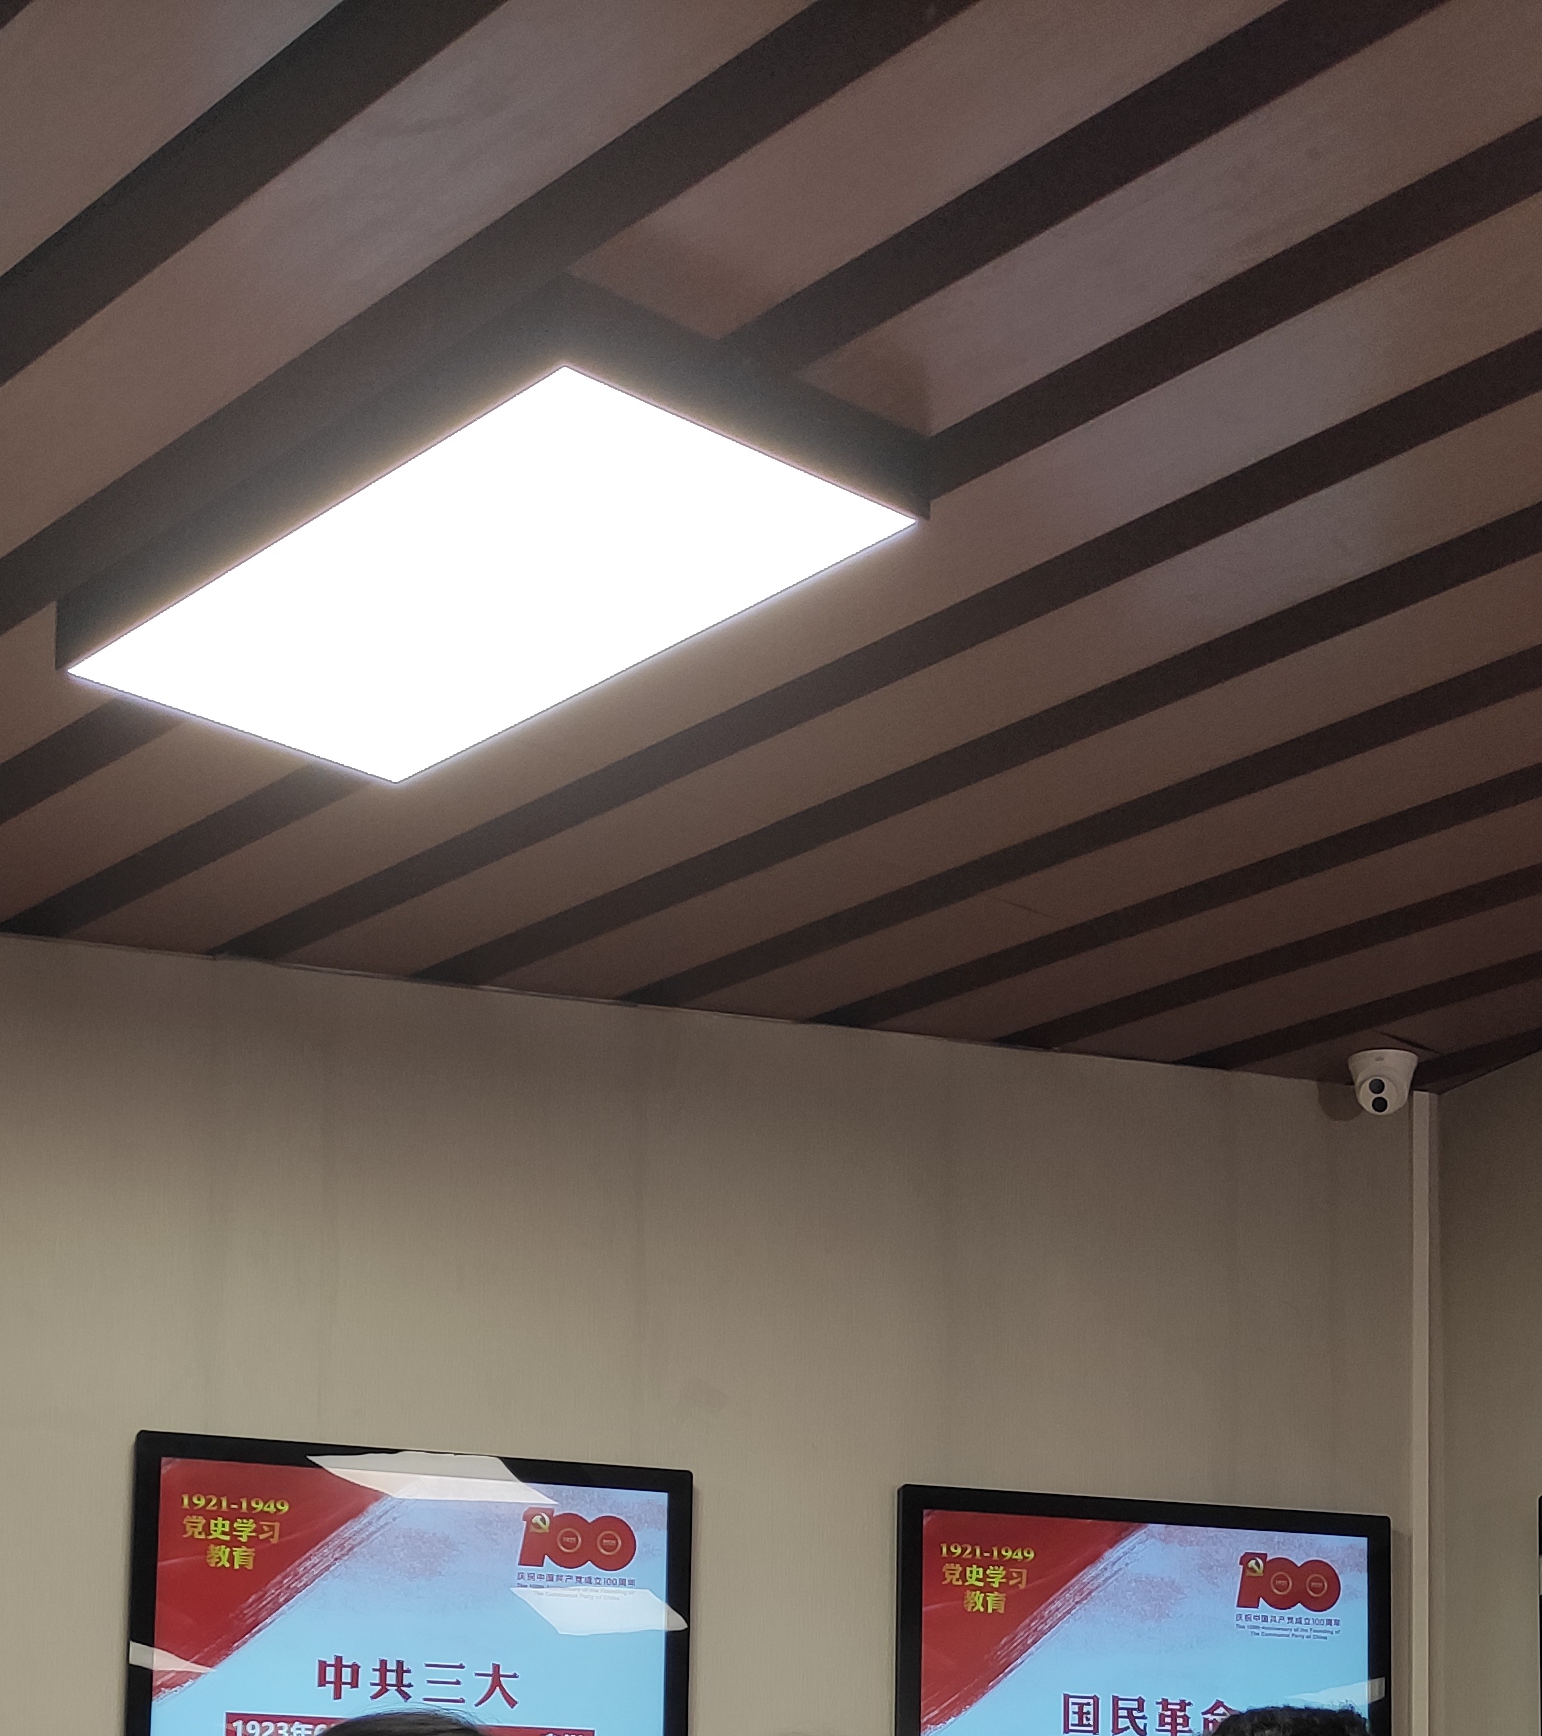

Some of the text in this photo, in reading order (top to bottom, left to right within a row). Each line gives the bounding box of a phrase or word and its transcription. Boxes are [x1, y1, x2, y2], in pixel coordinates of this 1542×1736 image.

[181, 1494, 290, 1515] 1921-1949
[182, 1516, 281, 1544] 党史学习
[518, 1507, 636, 1571] 100
[206, 1544, 255, 1570] 教育
[939, 1543, 1035, 1563] 1921-1949
[942, 1562, 1028, 1589] 党史学习
[1236, 1552, 1341, 1612] 100
[963, 1589, 1007, 1615] 教育
[317, 1654, 520, 1709] 中共三大
